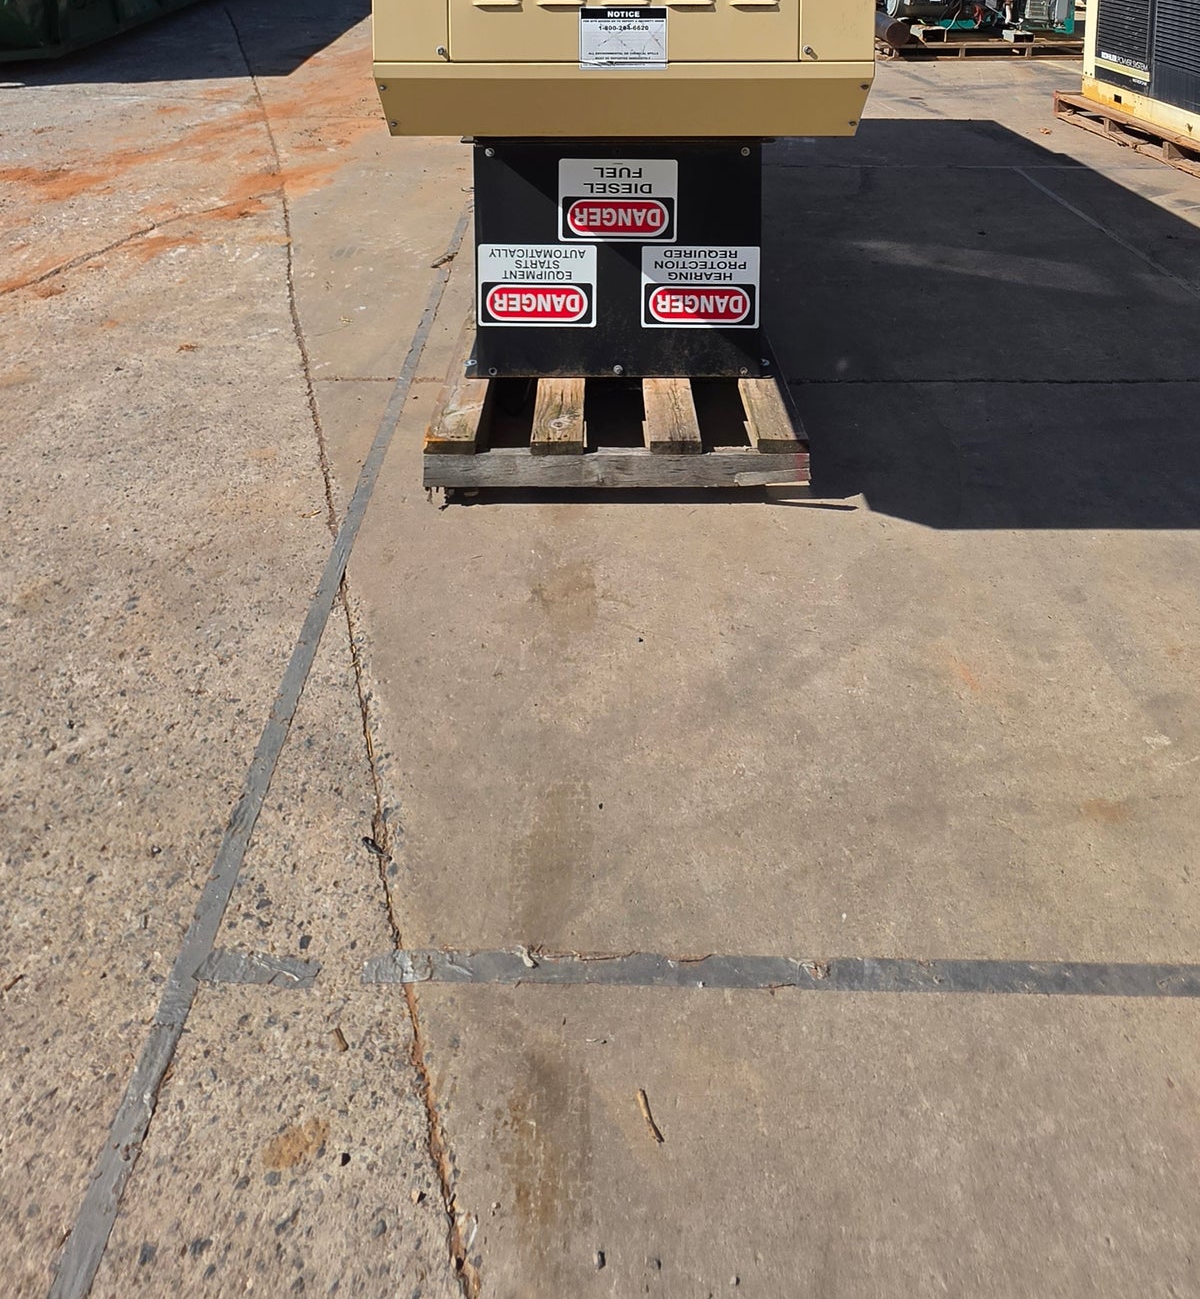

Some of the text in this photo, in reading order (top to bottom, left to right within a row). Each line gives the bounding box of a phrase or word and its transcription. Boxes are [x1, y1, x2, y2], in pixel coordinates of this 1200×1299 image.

[607, 10, 641, 18] NOTICE
[593, 167, 643, 178] FUEL
[583, 182, 652, 193] DIESEL
[574, 208, 661, 226] DANGER
[489, 248, 586, 258] AUTOMATICALLY
[663, 249, 738, 258] REQUIRED
[515, 259, 560, 269] STARTS
[654, 260, 746, 270] PROTECTION
[502, 270, 572, 279] EQUIPMENT
[668, 272, 732, 281] HEARING
[493, 293, 580, 312] DANGER
[656, 295, 743, 313] DANGER
